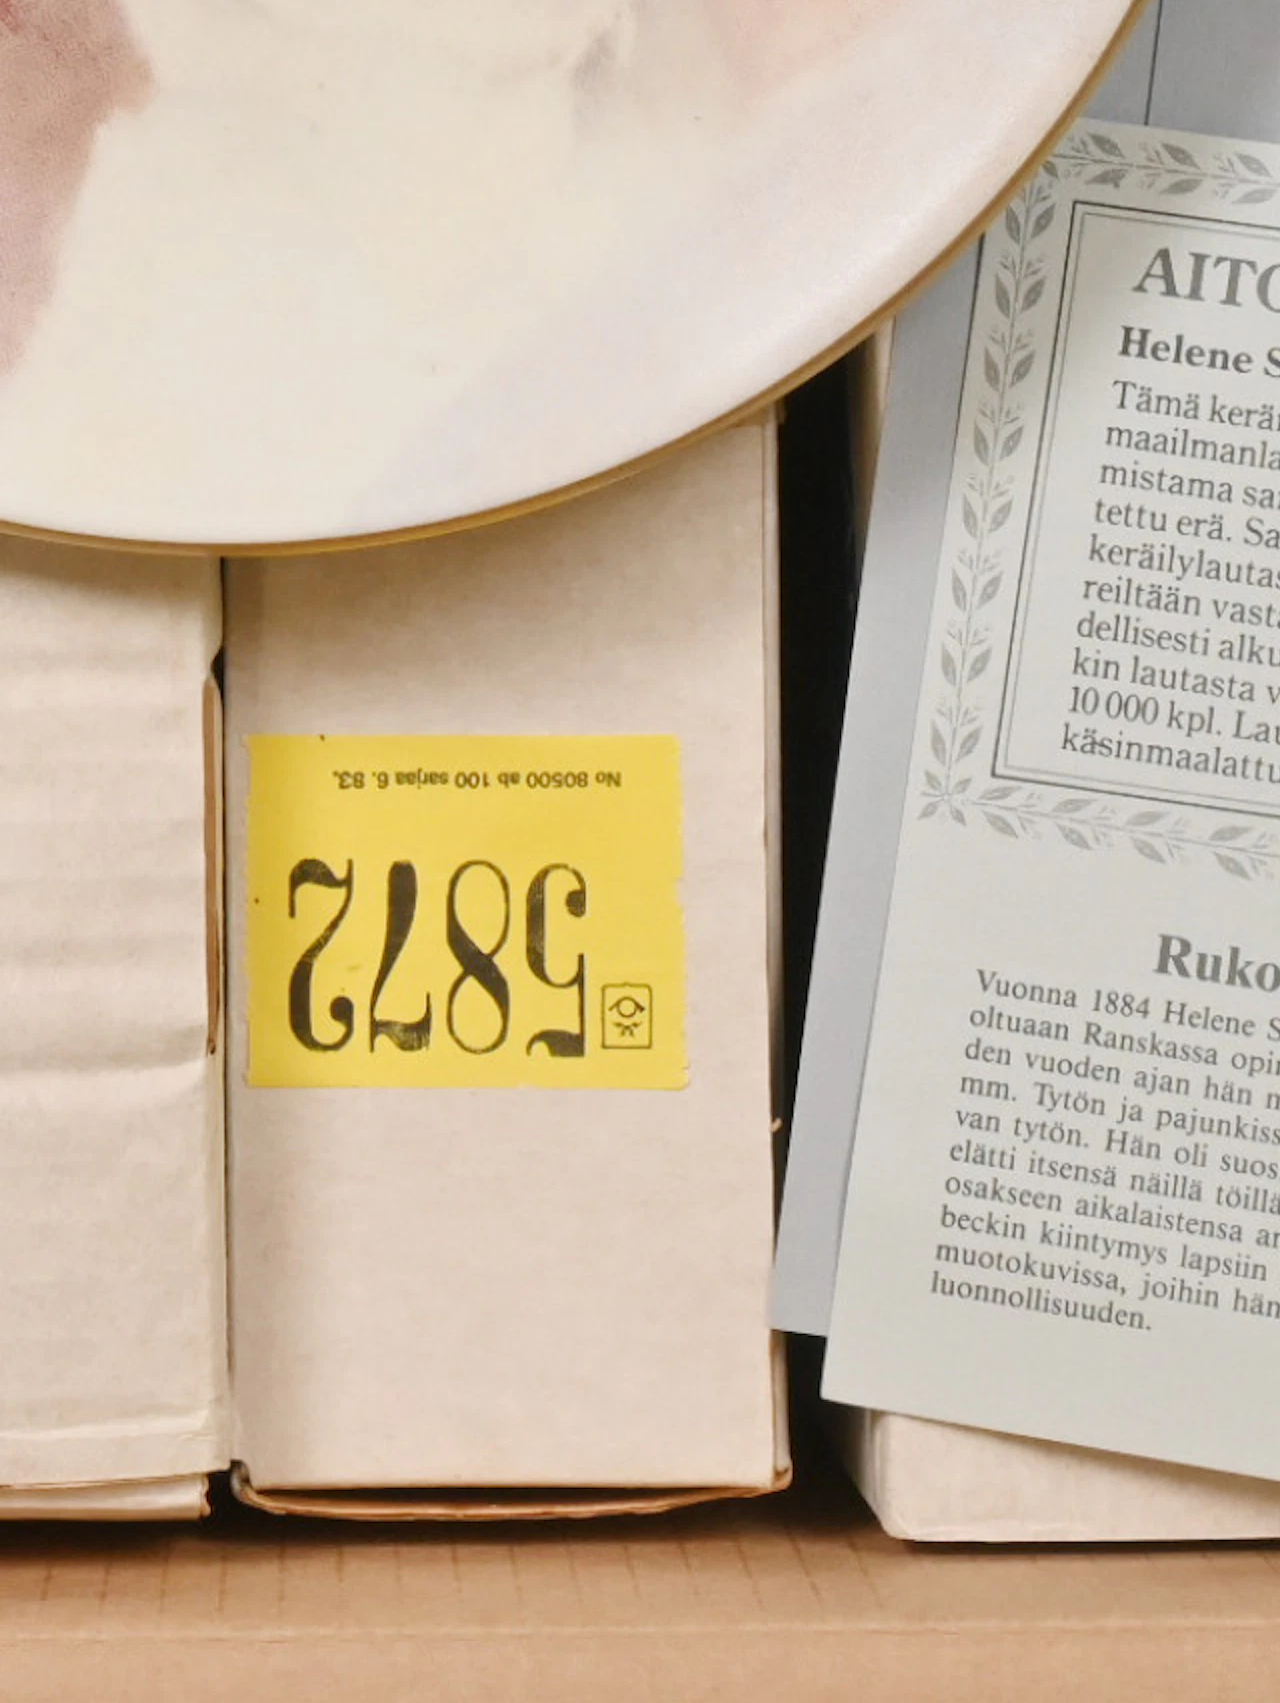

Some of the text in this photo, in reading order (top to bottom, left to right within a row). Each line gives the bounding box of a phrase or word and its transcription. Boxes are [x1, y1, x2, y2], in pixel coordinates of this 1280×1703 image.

[1117, 324, 1255, 375] Helene
[1111, 378, 1201, 421] Tämä
[1098, 459, 1234, 504] mistama
[1094, 498, 1168, 533] tettu
[1175, 512, 1233, 543] erä.
[1082, 574, 1202, 617] reiltään
[1075, 609, 1212, 657] dellisesti
[1071, 645, 1121, 683] kin
[1129, 653, 1256, 703] lautasta
[1165, 699, 1223, 739] kpl.
[395, 766, 450, 788] sarjaa
[455, 769, 491, 790] 100
[497, 768, 523, 790] ab
[526, 770, 588, 790] 80500
[595, 769, 624, 790] No
[288, 857, 587, 1058] 5872
[976, 968, 1078, 1009] Vuonna
[1091, 988, 1151, 1020] 1884
[1161, 998, 1257, 1038] Helene
[968, 1004, 1070, 1043] oltuaan
[1082, 1020, 1219, 1067] Ranskassa
[963, 1036, 1012, 1067] den
[1024, 1051, 1122, 1085] vuoden
[1132, 1065, 1191, 1097] ajan
[1203, 1074, 1253, 1107] hän
[959, 1075, 1018, 1103] mm.
[1033, 1080, 1106, 1117] Tytön
[1115, 1095, 1144, 1126] ja
[955, 1109, 1002, 1134] van
[1012, 1116, 1090, 1149] tytön.
[1103, 1127, 1162, 1162] Hän
[1173, 1141, 1209, 1169] oli
[948, 1138, 1017, 1172] elätti
[1027, 1149, 1118, 1189] itsensä
[1129, 1171, 1203, 1203] näillä
[943, 1175, 1063, 1213] osakseen
[1073, 1193, 1243, 1244] aikalaistensa
[939, 1202, 1027, 1242] beckin
[1039, 1219, 1168, 1267] kiintymys
[1179, 1243, 1268, 1283] lapsiin
[930, 1269, 1153, 1332] luonnollisuuden.
[934, 1243, 1127, 1297] muotokuvissa,
[1137, 1271, 1220, 1310] joihin
